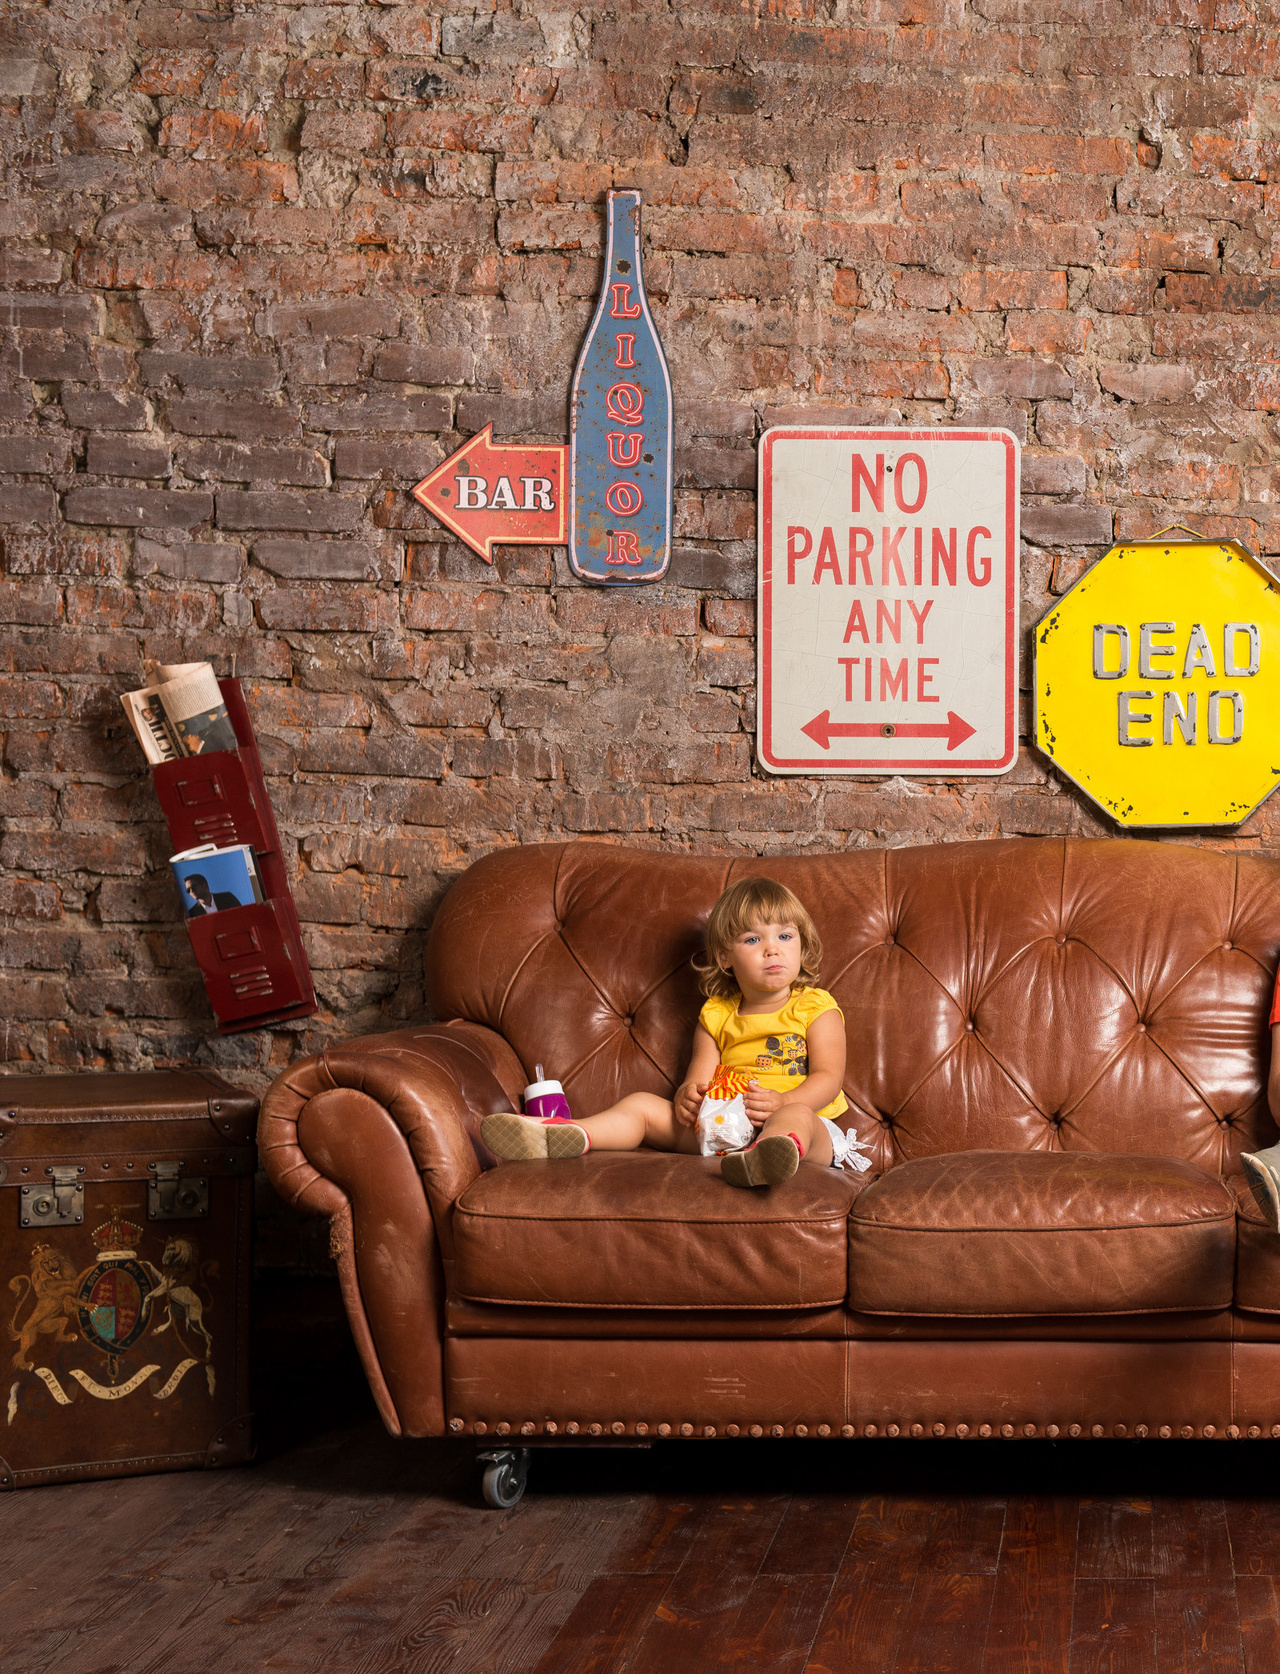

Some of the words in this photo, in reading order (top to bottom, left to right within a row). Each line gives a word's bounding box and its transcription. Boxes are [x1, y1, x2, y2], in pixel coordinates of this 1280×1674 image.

[606, 283, 644, 565] LIQUOR
[455, 476, 555, 512] BAR
[851, 452, 928, 514] NO
[787, 526, 992, 587] PARKING
[842, 599, 934, 644] ANY
[1092, 622, 1261, 680] DEAD
[838, 658, 940, 702] TIME
[1117, 690, 1244, 747] END
